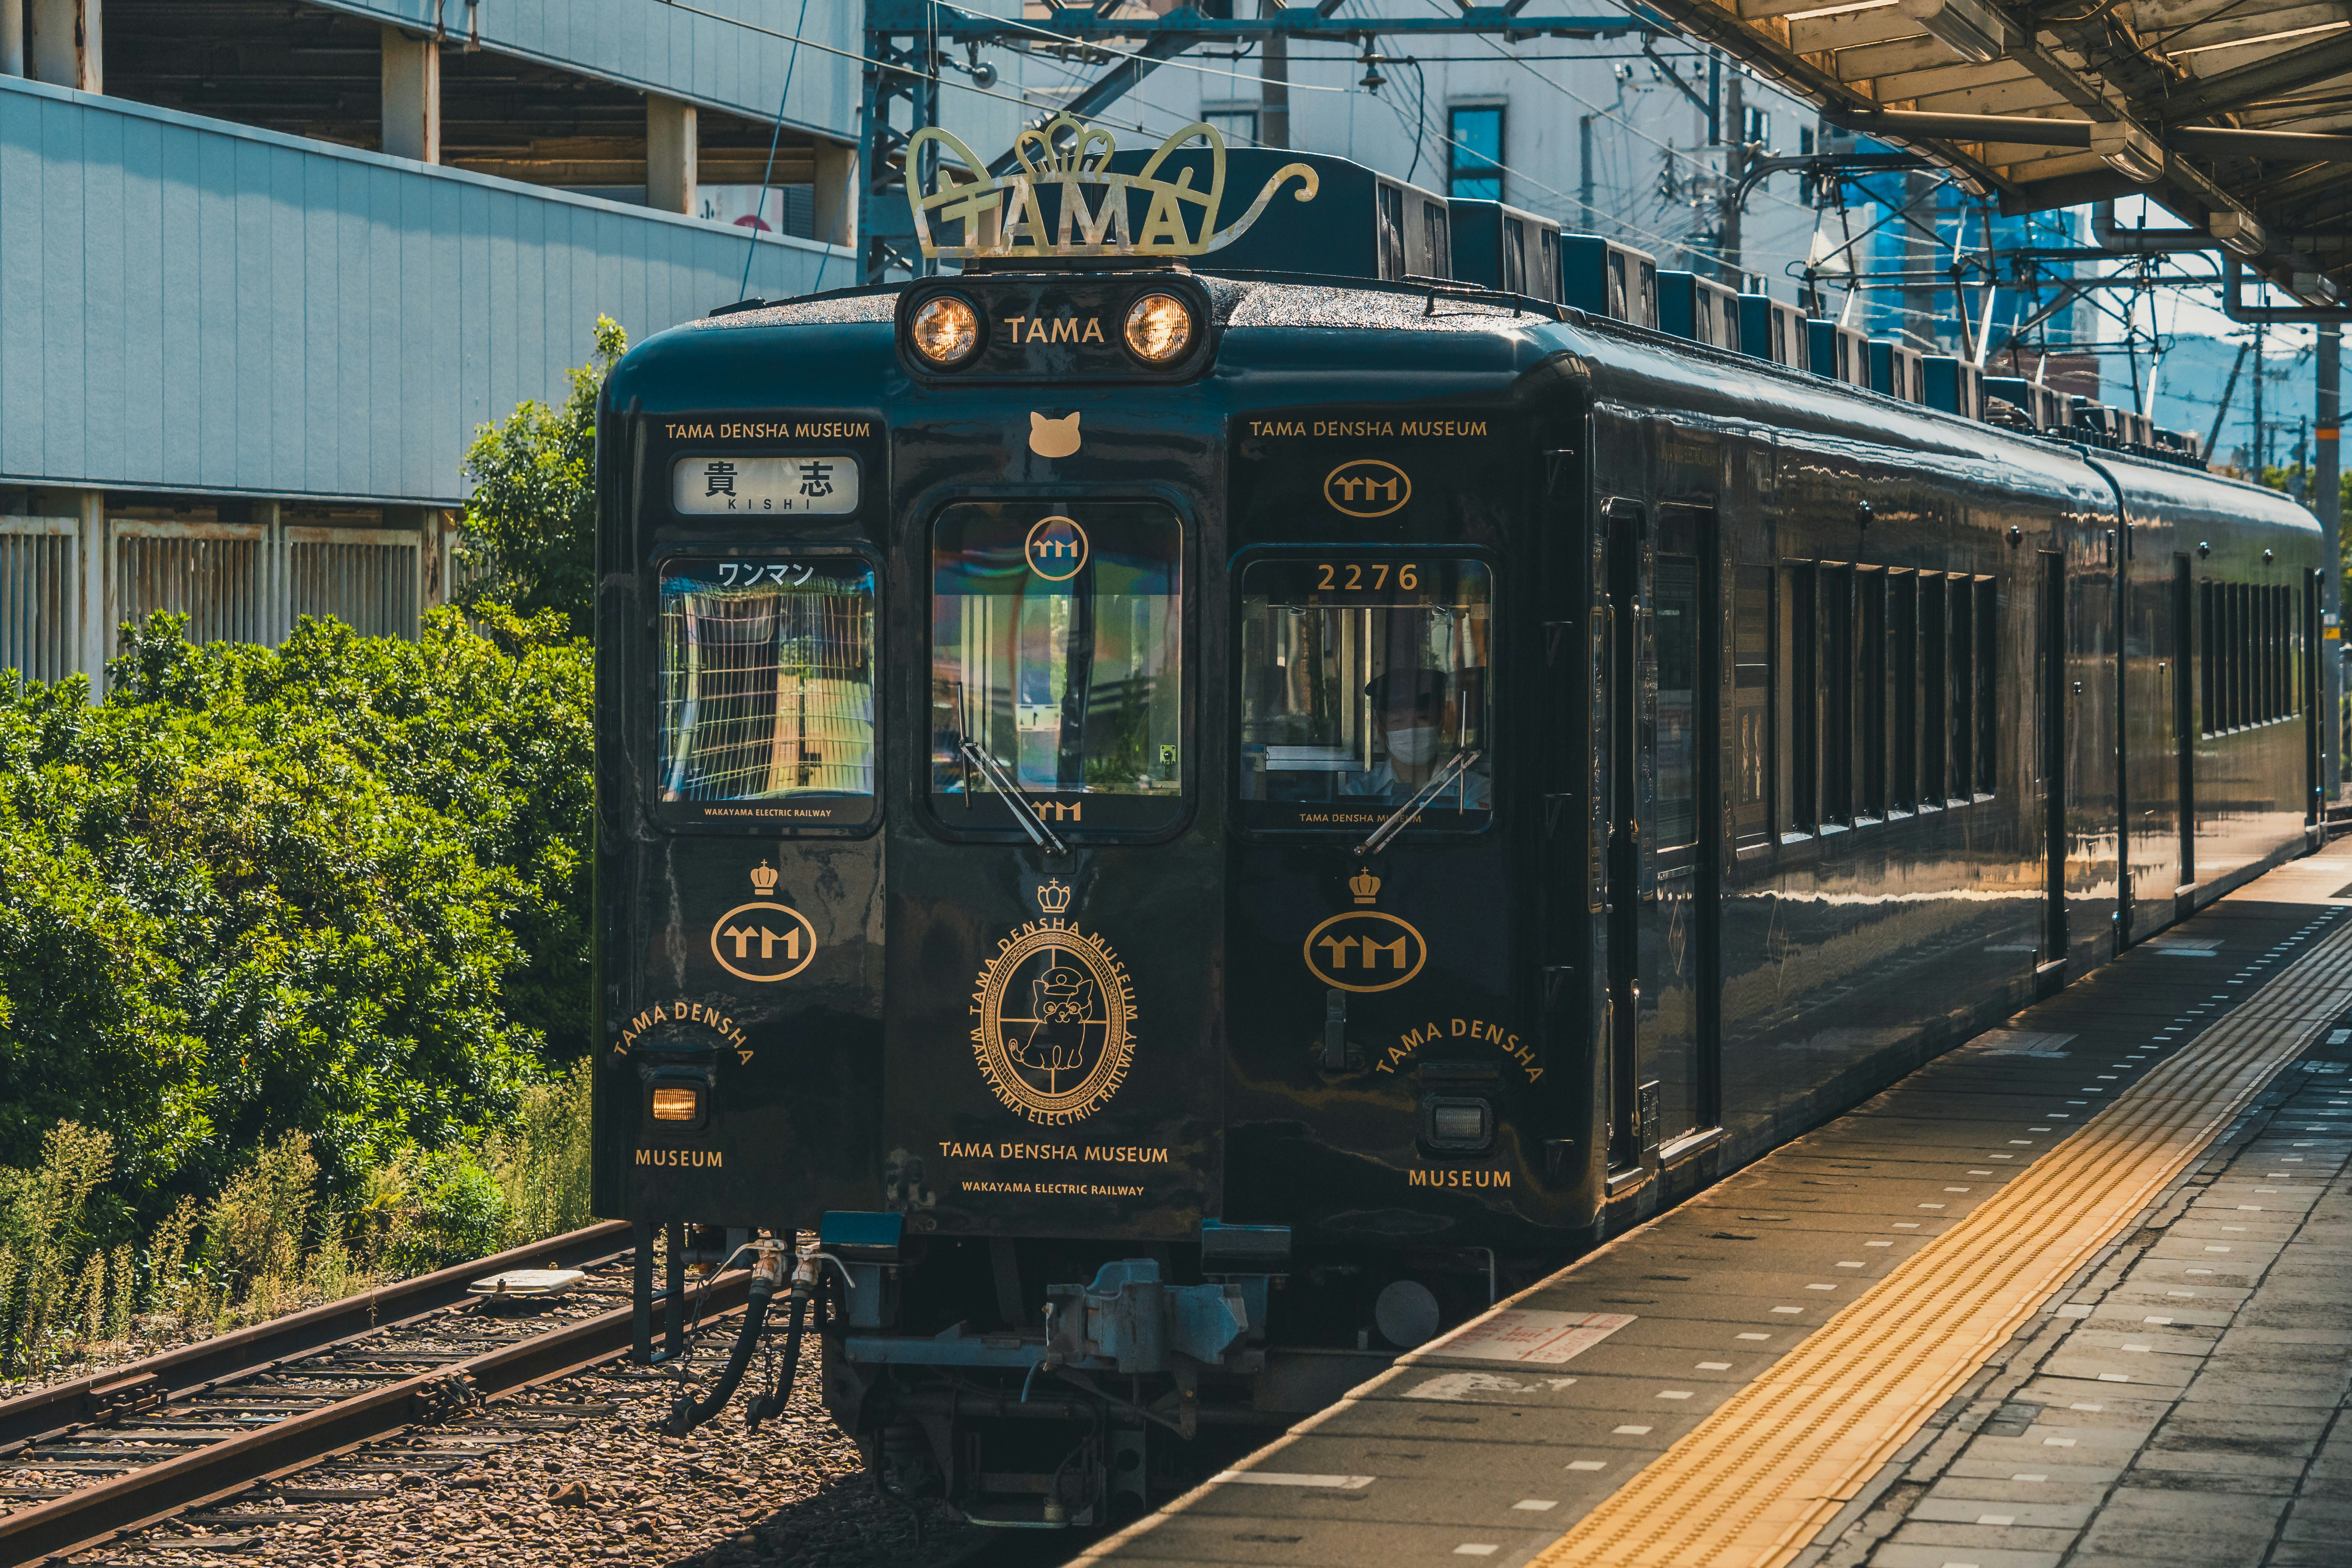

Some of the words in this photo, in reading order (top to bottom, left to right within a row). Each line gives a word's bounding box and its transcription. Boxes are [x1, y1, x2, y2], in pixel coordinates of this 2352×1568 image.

[941, 173, 1192, 257] TAMA
[1004, 317, 1104, 343] TAMA
[666, 424, 714, 438] TAMA
[721, 423, 789, 438] DENSHA
[795, 423, 870, 437] MUSEUM
[1250, 421, 1306, 436] TAMA
[1314, 421, 1394, 436] DENSHA
[1401, 421, 1487, 436] MUSEUM
[704, 461, 833, 497] 貴志
[728, 499, 809, 509] KISHI
[719, 564, 813, 586] ワンマン
[1318, 565, 1417, 590] 2276
[1332, 814, 1373, 822] DENSHA
[970, 959, 997, 1015] TAMA
[997, 917, 1079, 952] DENSHA
[1088, 932, 1138, 1020] MUSEUM
[614, 1006, 667, 1055] TAMA
[675, 1002, 754, 1065] DENSHA
[1376, 1022, 1442, 1073] TAMA
[1452, 1019, 1544, 1083] DENSHA
[970, 1027, 1023, 1116] WAKAYAMA
[1028, 1099, 1101, 1126] ELECTRIC
[1098, 1031, 1137, 1102] RAILWAY
[636, 1149, 722, 1167] MUSEUM
[939, 1141, 994, 1158] TAMA
[1001, 1143, 1078, 1159] DENSHA
[1085, 1146, 1168, 1163] MUSEUM
[962, 1182, 1031, 1192] WAKAYAMA
[1035, 1183, 1087, 1194] ELECTRIC
[1091, 1185, 1144, 1195] RAILWAY
[1409, 1170, 1511, 1187] MUSEUM
